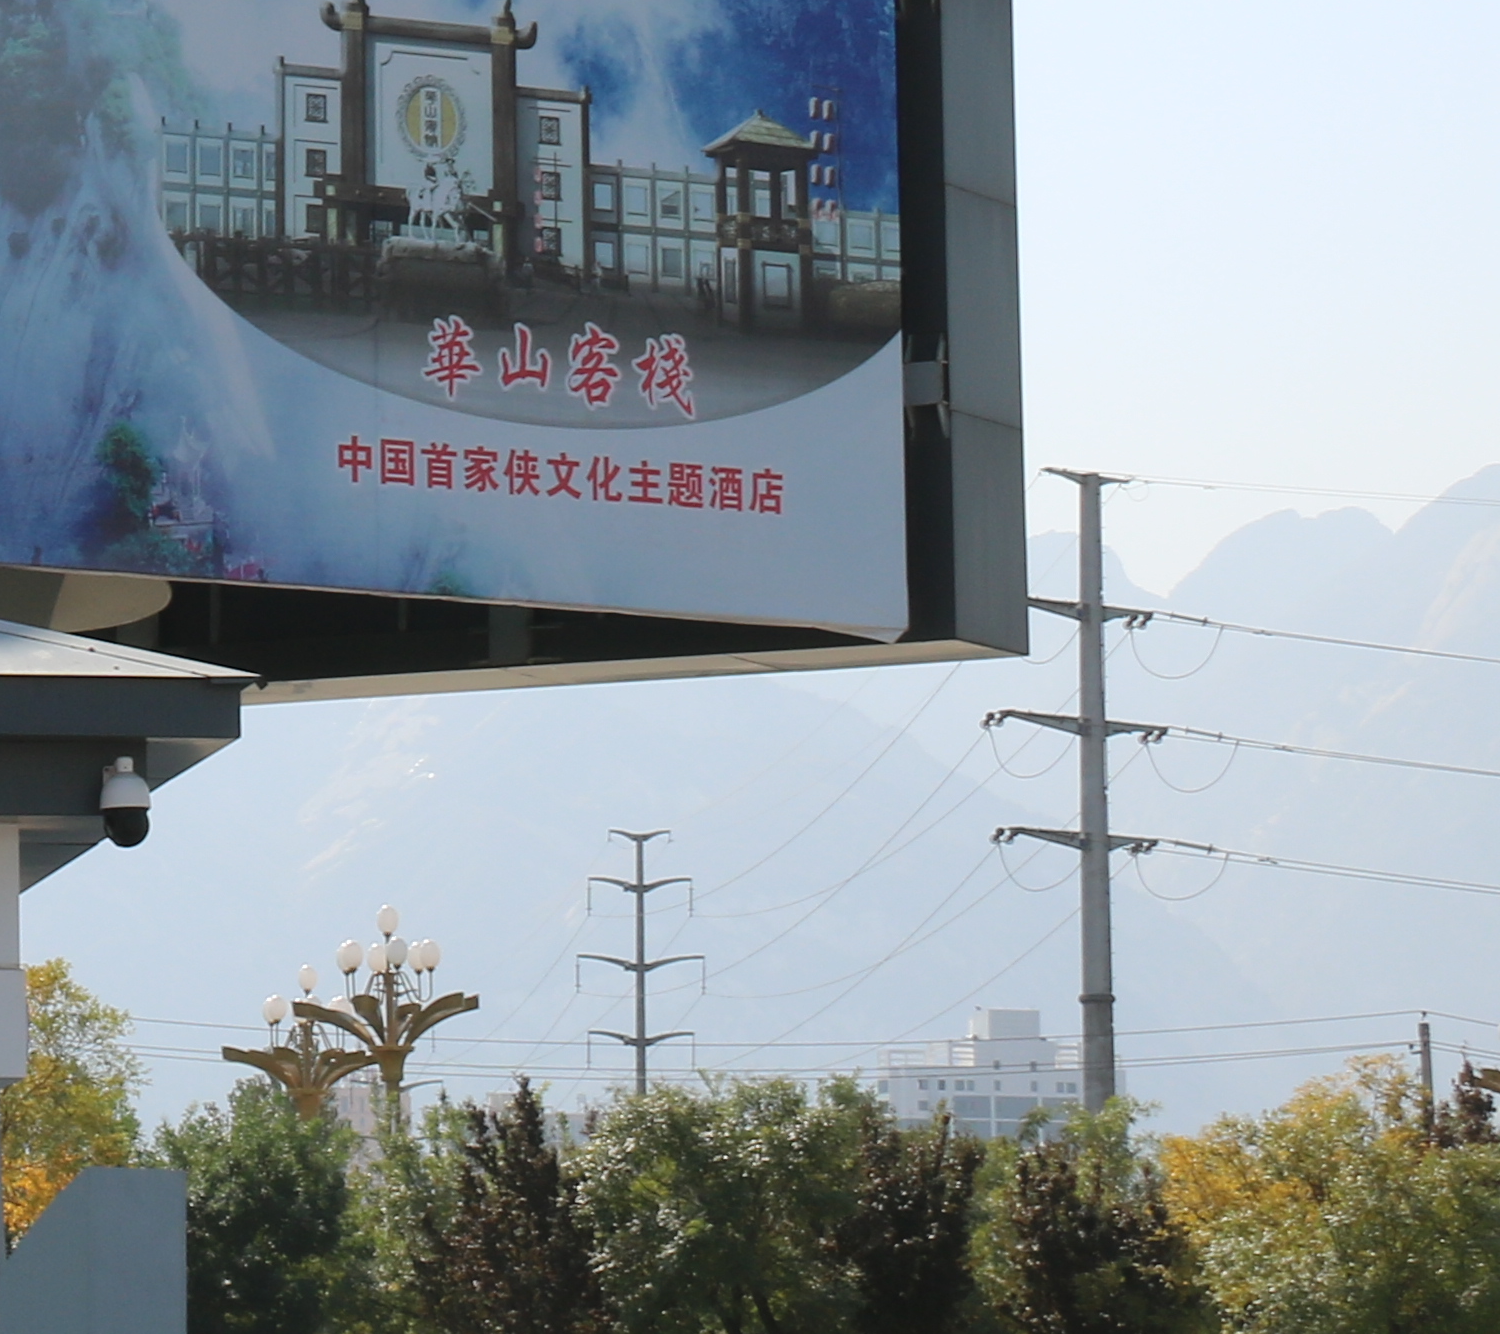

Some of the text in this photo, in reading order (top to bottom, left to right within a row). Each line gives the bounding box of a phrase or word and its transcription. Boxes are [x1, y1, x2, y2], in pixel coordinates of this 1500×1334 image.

[337, 433, 784, 515] 中国首家侠文化主题酒店
